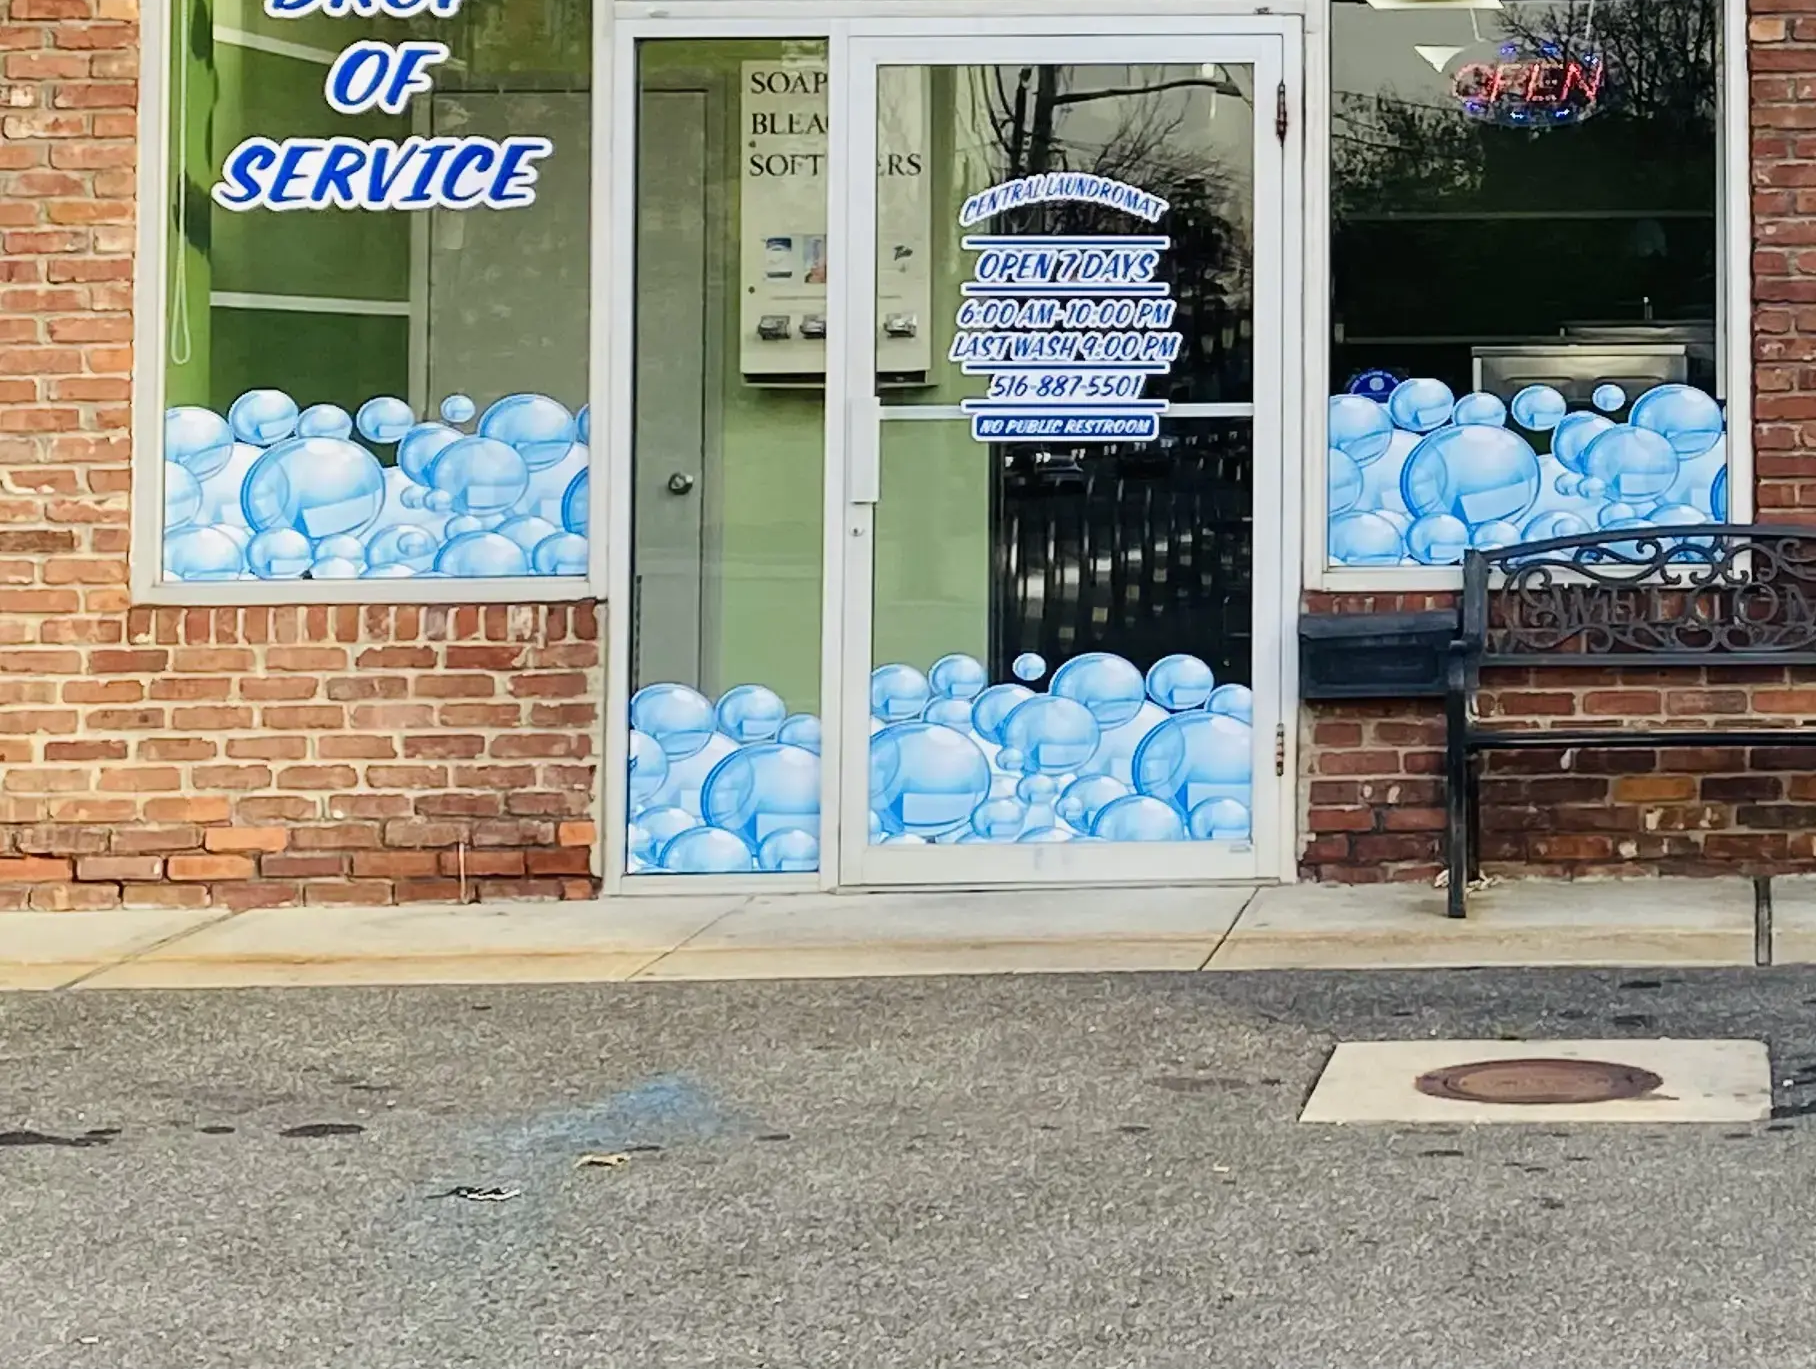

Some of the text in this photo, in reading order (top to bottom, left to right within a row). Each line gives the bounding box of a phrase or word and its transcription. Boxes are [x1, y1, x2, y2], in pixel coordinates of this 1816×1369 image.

[329, 44, 445, 110] OF
[750, 71, 828, 94] SOAP
[1452, 62, 1605, 103] OPEN
[751, 112, 828, 135] BLEA
[218, 140, 549, 206] SERVICE
[962, 175, 1166, 223] CENTRAL LAUNDROMAT
[977, 251, 1157, 281] OPEN 7 DAYS
[959, 301, 1016, 326] 6:00
[1136, 301, 1174, 326] PM
[952, 334, 1180, 359] LAST WASH 9:00 PM
[989, 373, 1143, 398] 516-887-5501
[978, 418, 1151, 434] NO PUBLIC RESTROOM
